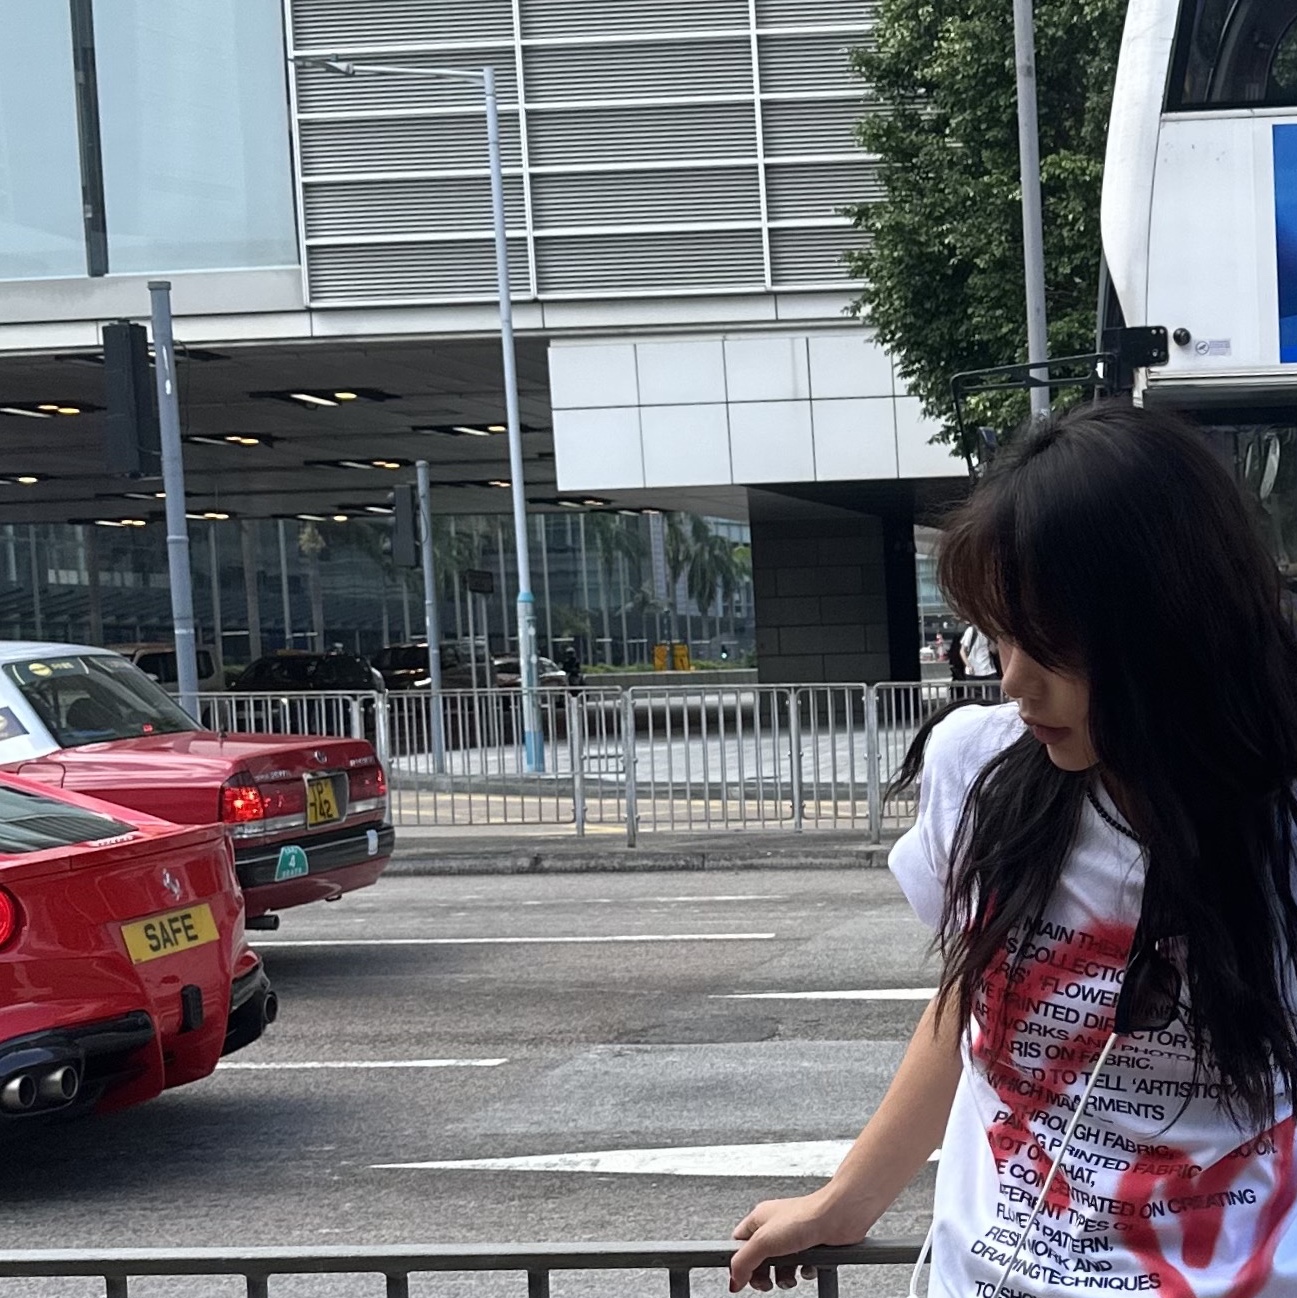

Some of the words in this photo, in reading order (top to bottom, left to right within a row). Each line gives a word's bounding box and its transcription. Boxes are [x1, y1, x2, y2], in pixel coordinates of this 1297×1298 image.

[288, 855, 295, 867] 4
[144, 913, 199, 952] SAFE
[999, 990, 1080, 1024] RINTED
[1084, 1012, 1187, 1049] DIRCTOR
[1045, 1044, 1075, 1060] ON
[1120, 1044, 1196, 1063] PHOTO
[1050, 1068, 1077, 1085] TO
[1081, 1071, 1127, 1092] TELL
[1049, 1138, 1131, 1172] PRINTED
[1132, 1162, 1203, 1179] FABRIC
[1140, 1200, 1165, 1219] ON
[1168, 1188, 1257, 1214] CREATING
[971, 1240, 1041, 1280] DRAING
[1041, 1266, 1162, 1291] TECHNIQUES
[1073, 1258, 1113, 1273] AND
